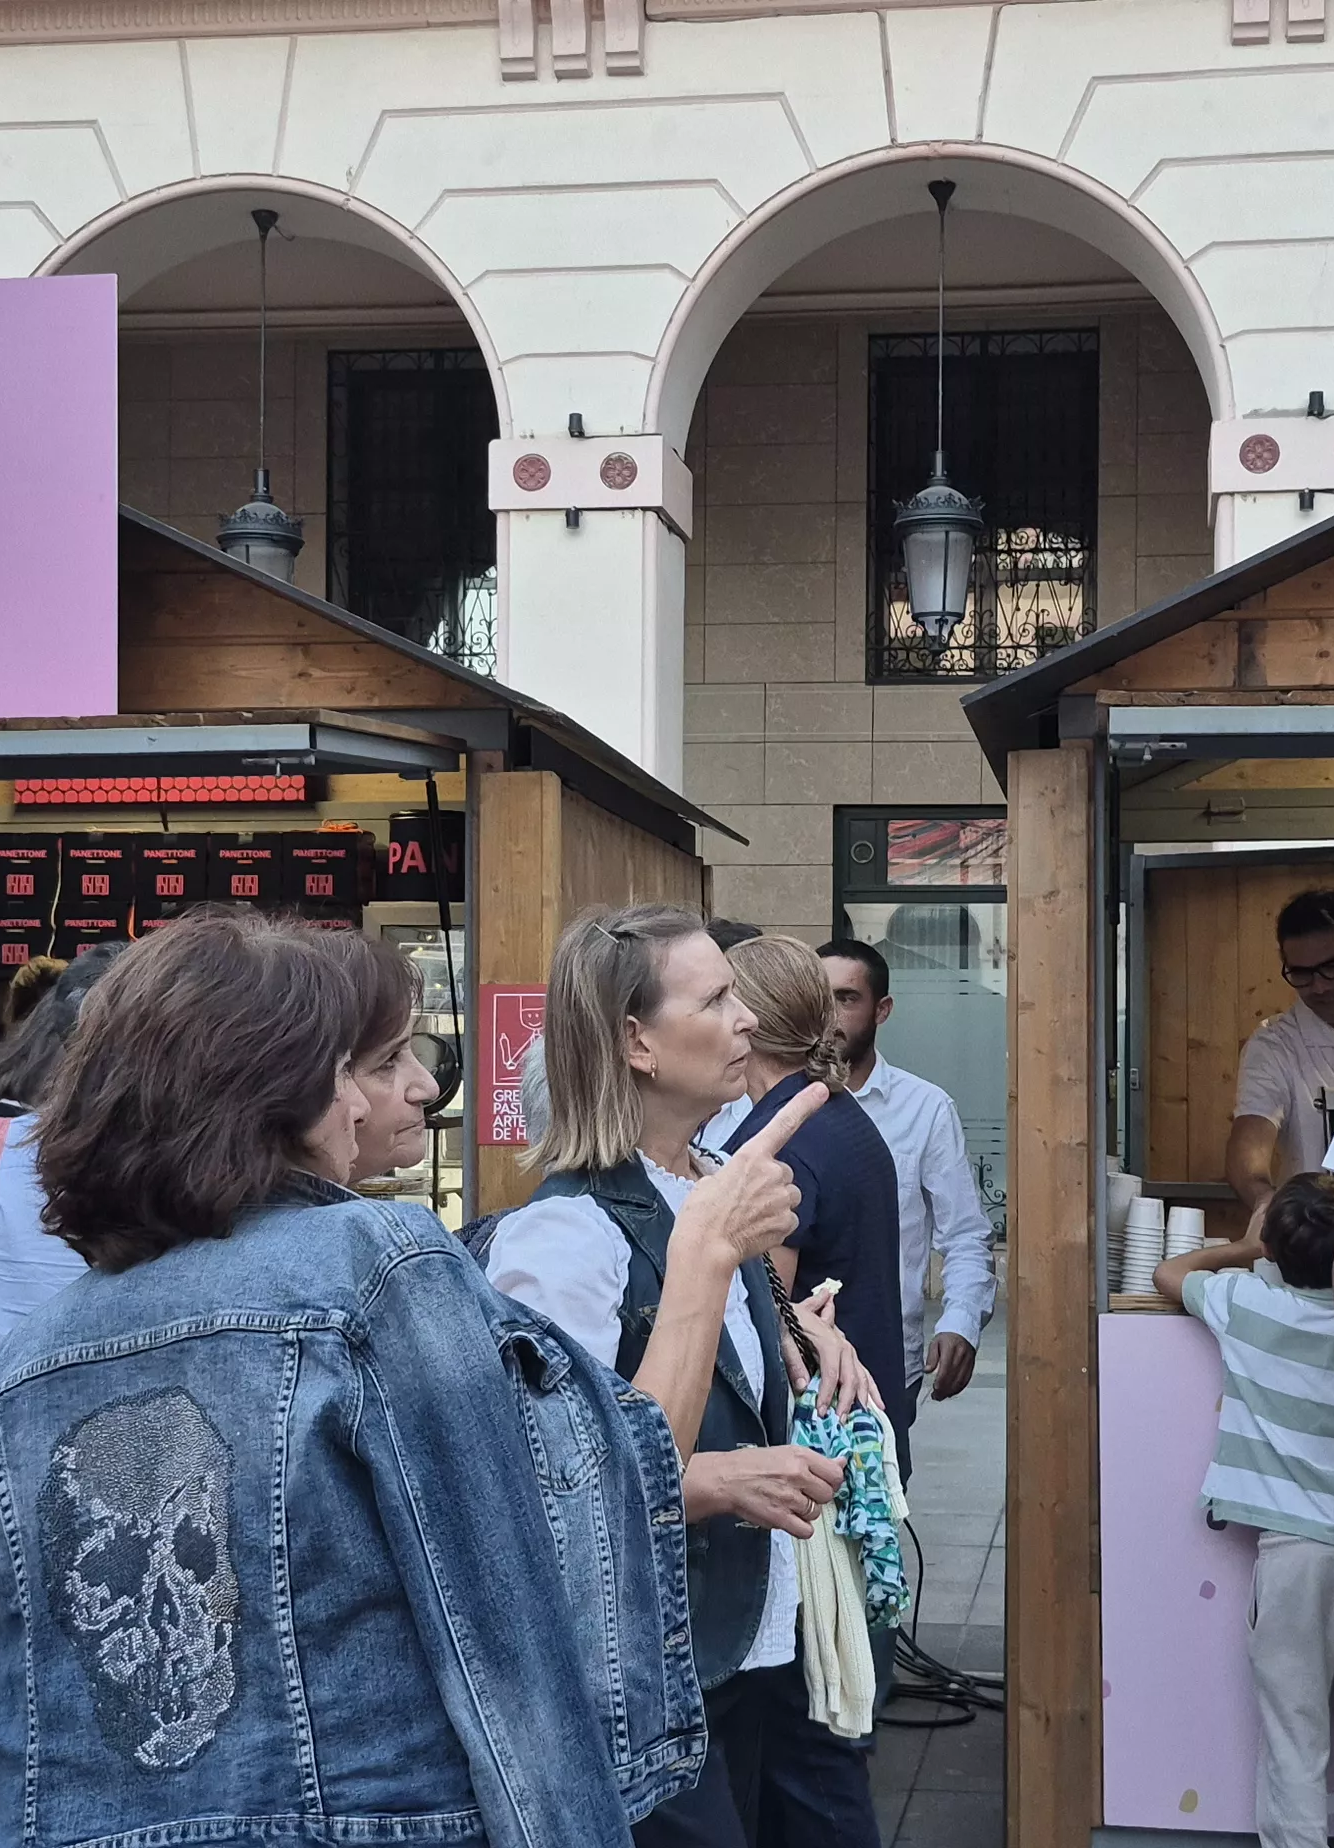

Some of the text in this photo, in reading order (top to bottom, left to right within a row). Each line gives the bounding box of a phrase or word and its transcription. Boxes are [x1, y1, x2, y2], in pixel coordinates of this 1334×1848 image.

[70, 849, 122, 859] PANETTONE
[143, 849, 197, 859] PANETTONE
[219, 849, 272, 859] PANETTONE
[293, 849, 346, 859] PANETTONE
[64, 919, 117, 928] PANETTONE
[493, 1128, 512, 1140] DE
